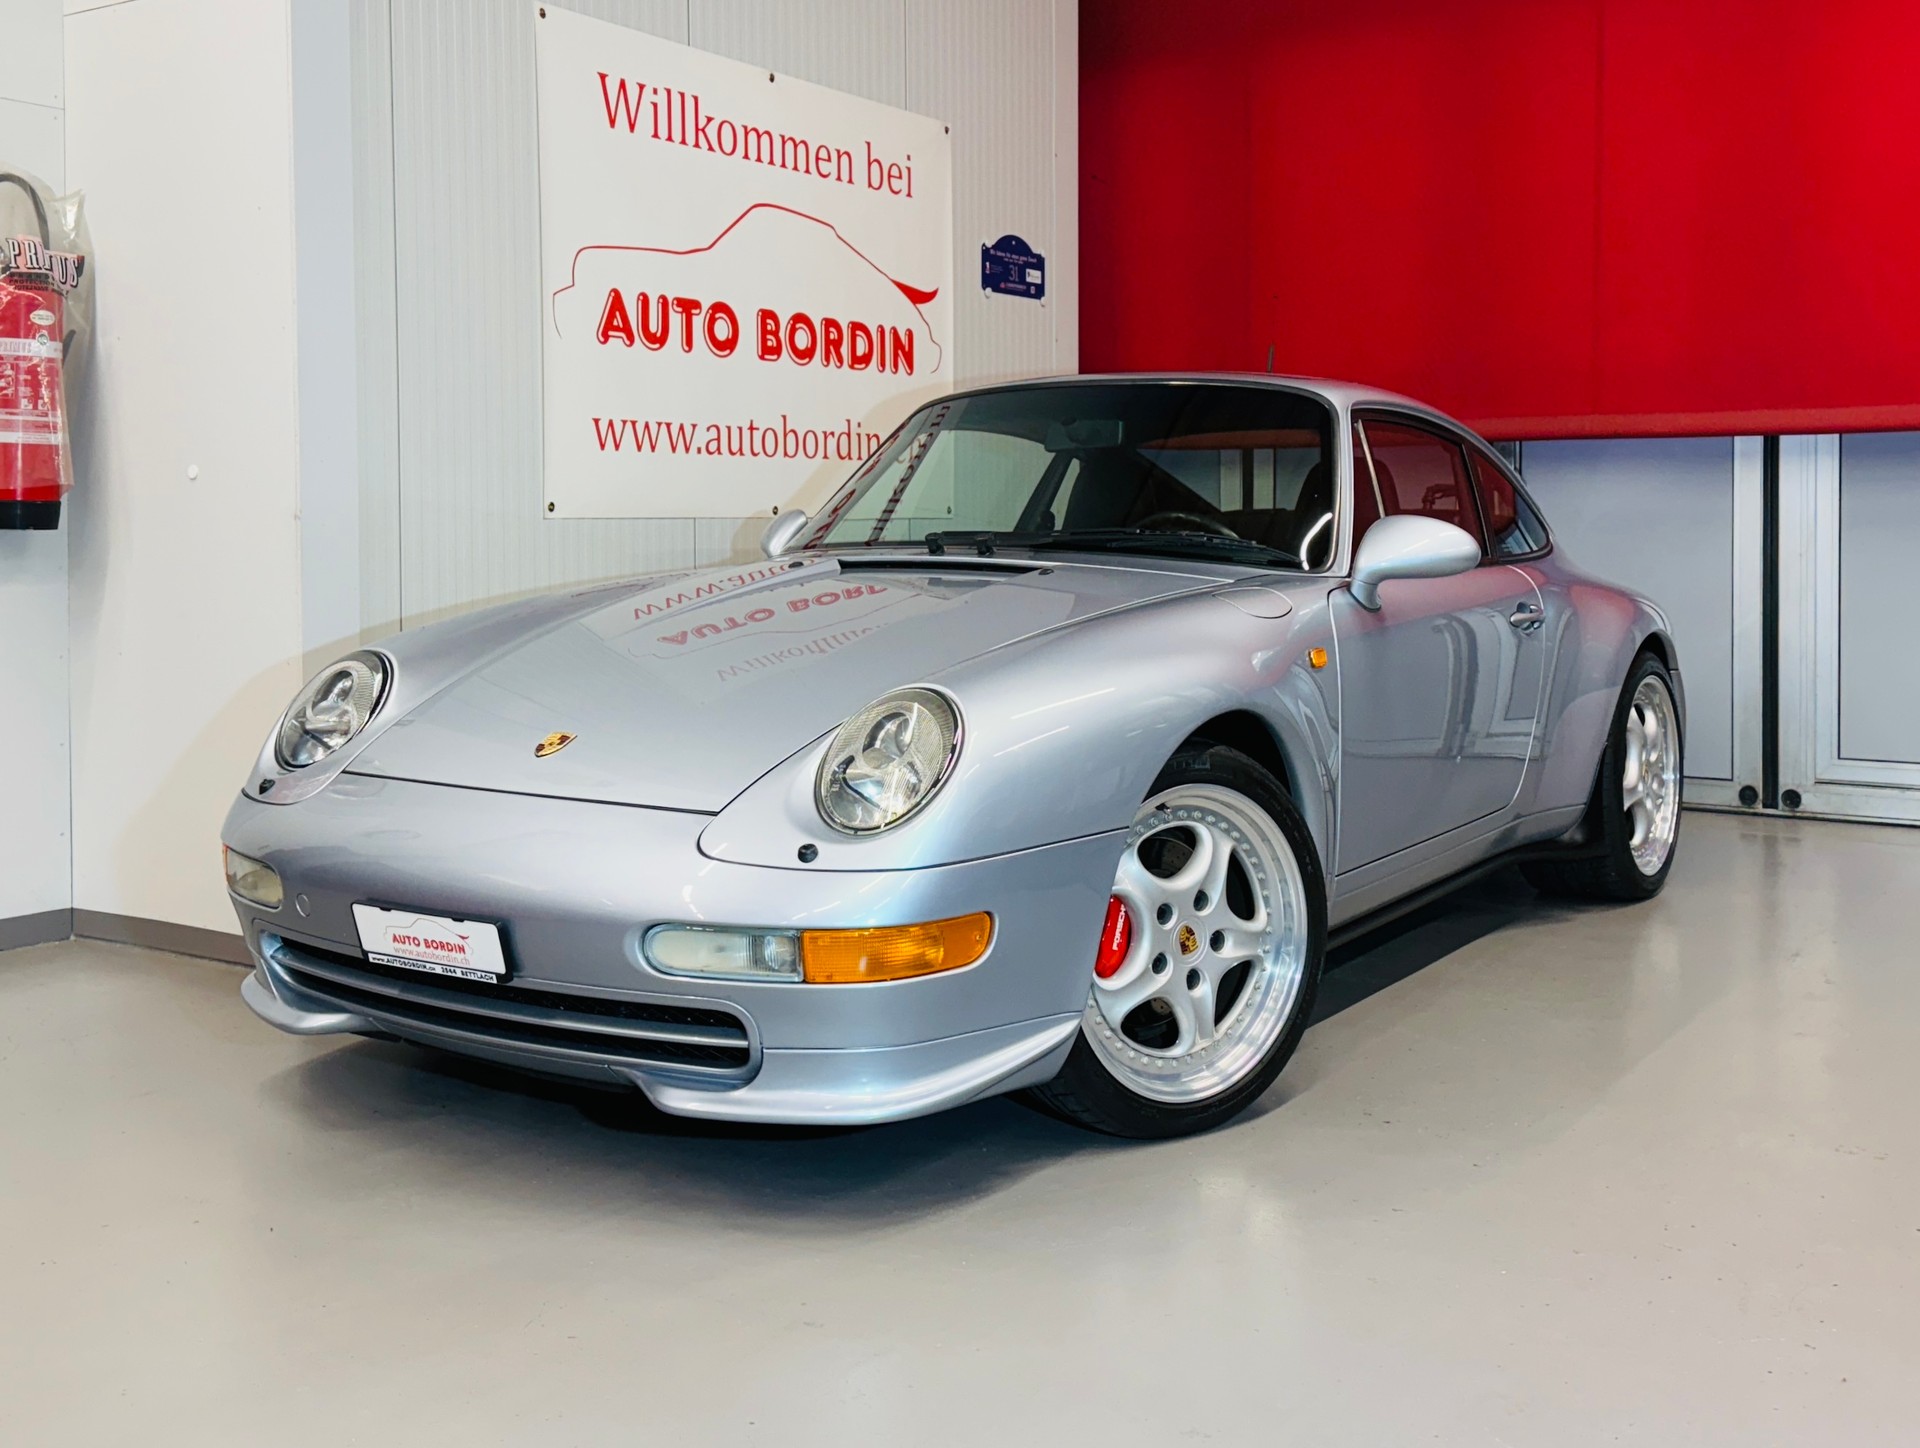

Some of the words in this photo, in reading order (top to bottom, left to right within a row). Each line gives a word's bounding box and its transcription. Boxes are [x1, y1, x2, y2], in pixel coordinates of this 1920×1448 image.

[598, 71, 855, 186] Willkommen
[865, 140, 913, 199] bei
[596, 287, 741, 360] AUTO
[756, 307, 915, 376] BORDIN
[392, 933, 421, 947] AUTO
[423, 938, 466, 955] BORDIN
[393, 946, 471, 966] www.autobordin.ch
[461, 969, 495, 982] BETTLACH
